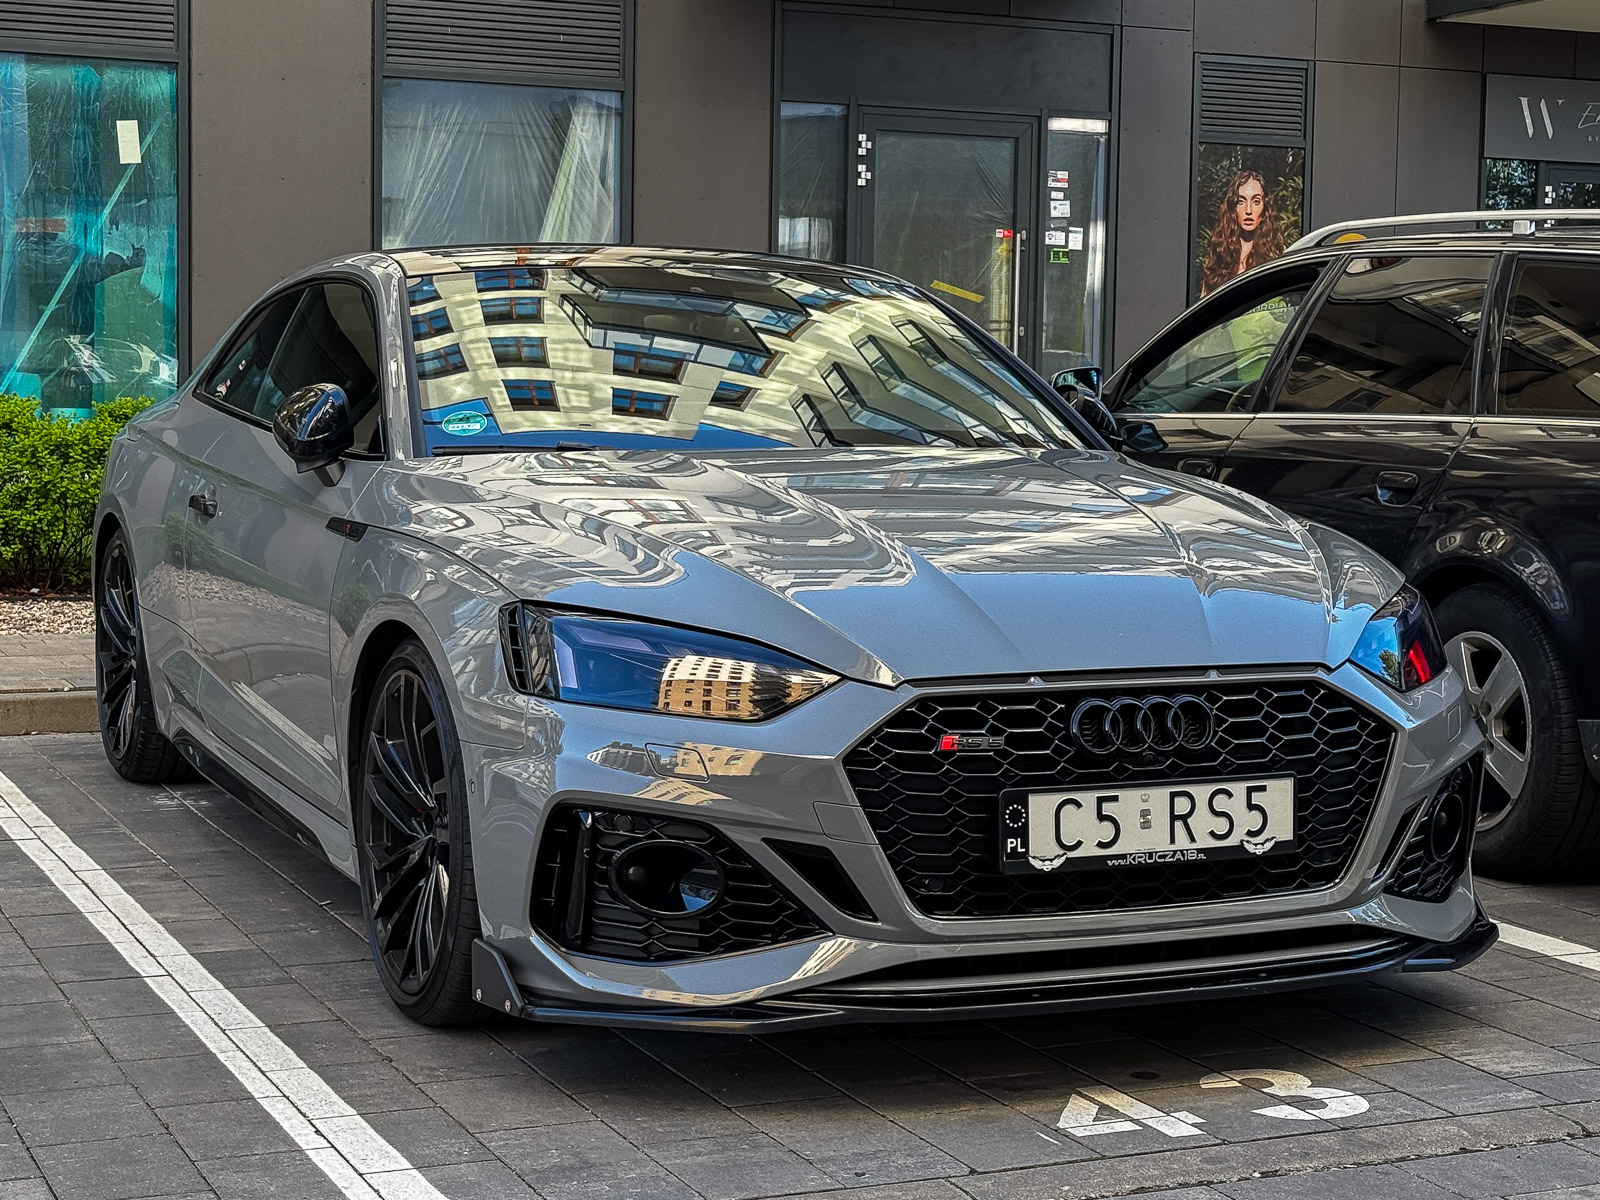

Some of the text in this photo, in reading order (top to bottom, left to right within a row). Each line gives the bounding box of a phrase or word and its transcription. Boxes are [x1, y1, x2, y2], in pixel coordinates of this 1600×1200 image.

[1007, 837, 1026, 853] PL
[1053, 784, 1269, 852] C5 RS5
[1056, 1068, 1370, 1137] 43
